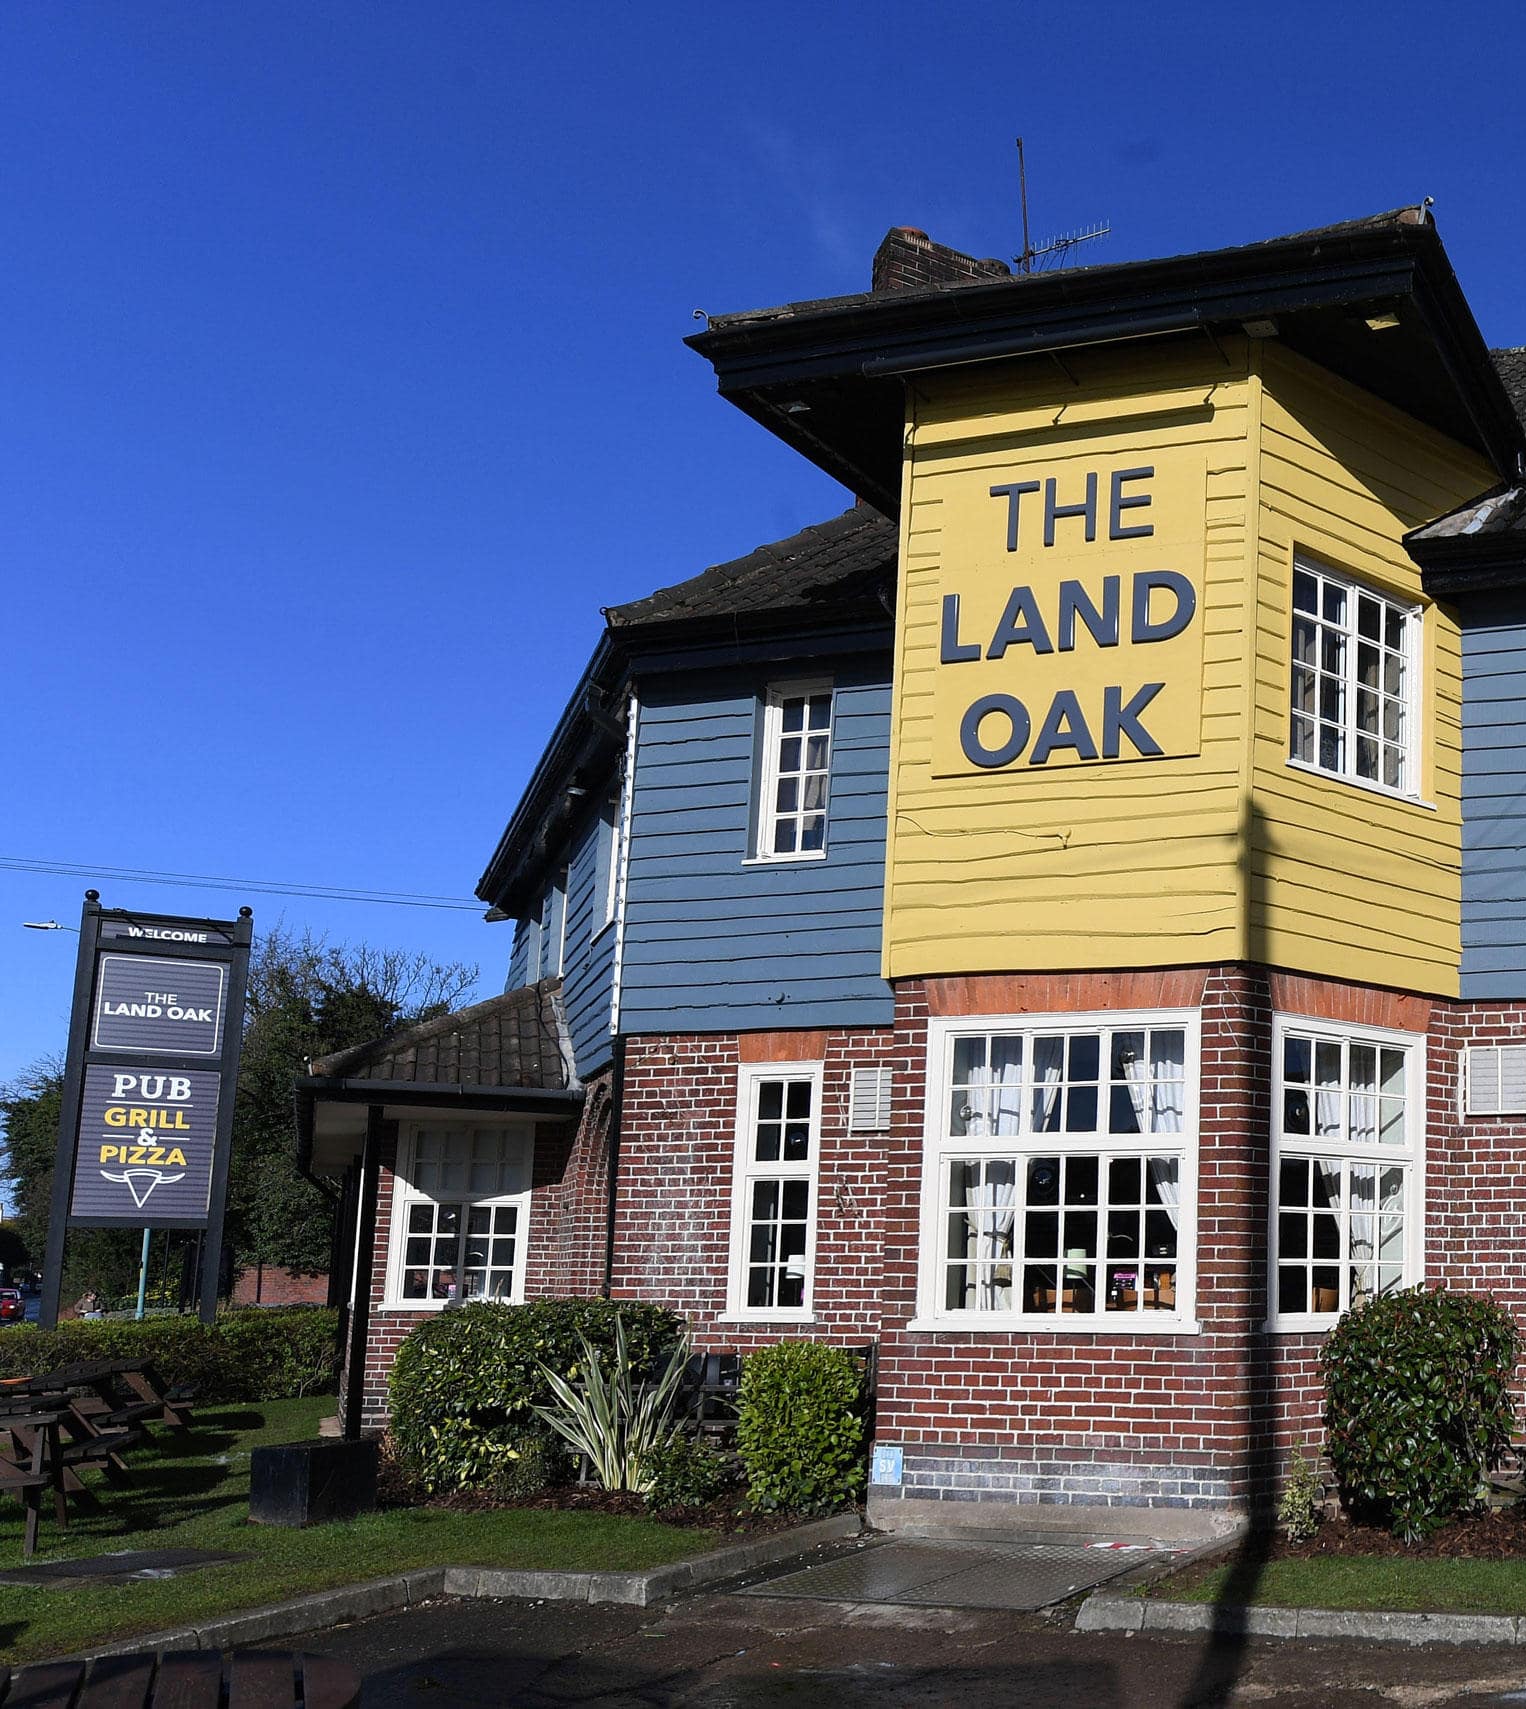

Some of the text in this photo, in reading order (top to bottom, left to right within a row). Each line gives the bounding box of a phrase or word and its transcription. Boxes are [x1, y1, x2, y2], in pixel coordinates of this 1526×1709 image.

[990, 465, 1155, 553] THE
[940, 570, 1197, 664] LAND
[959, 682, 1166, 769] OAK
[128, 927, 208, 943] WELCOME
[144, 992, 178, 1005] THE
[104, 1002, 213, 1022] LAND OAK
[111, 1074, 192, 1100] PUB
[104, 1107, 191, 1129] GRILL
[137, 1128, 158, 1146] &
[100, 1145, 187, 1166] PIZZA
